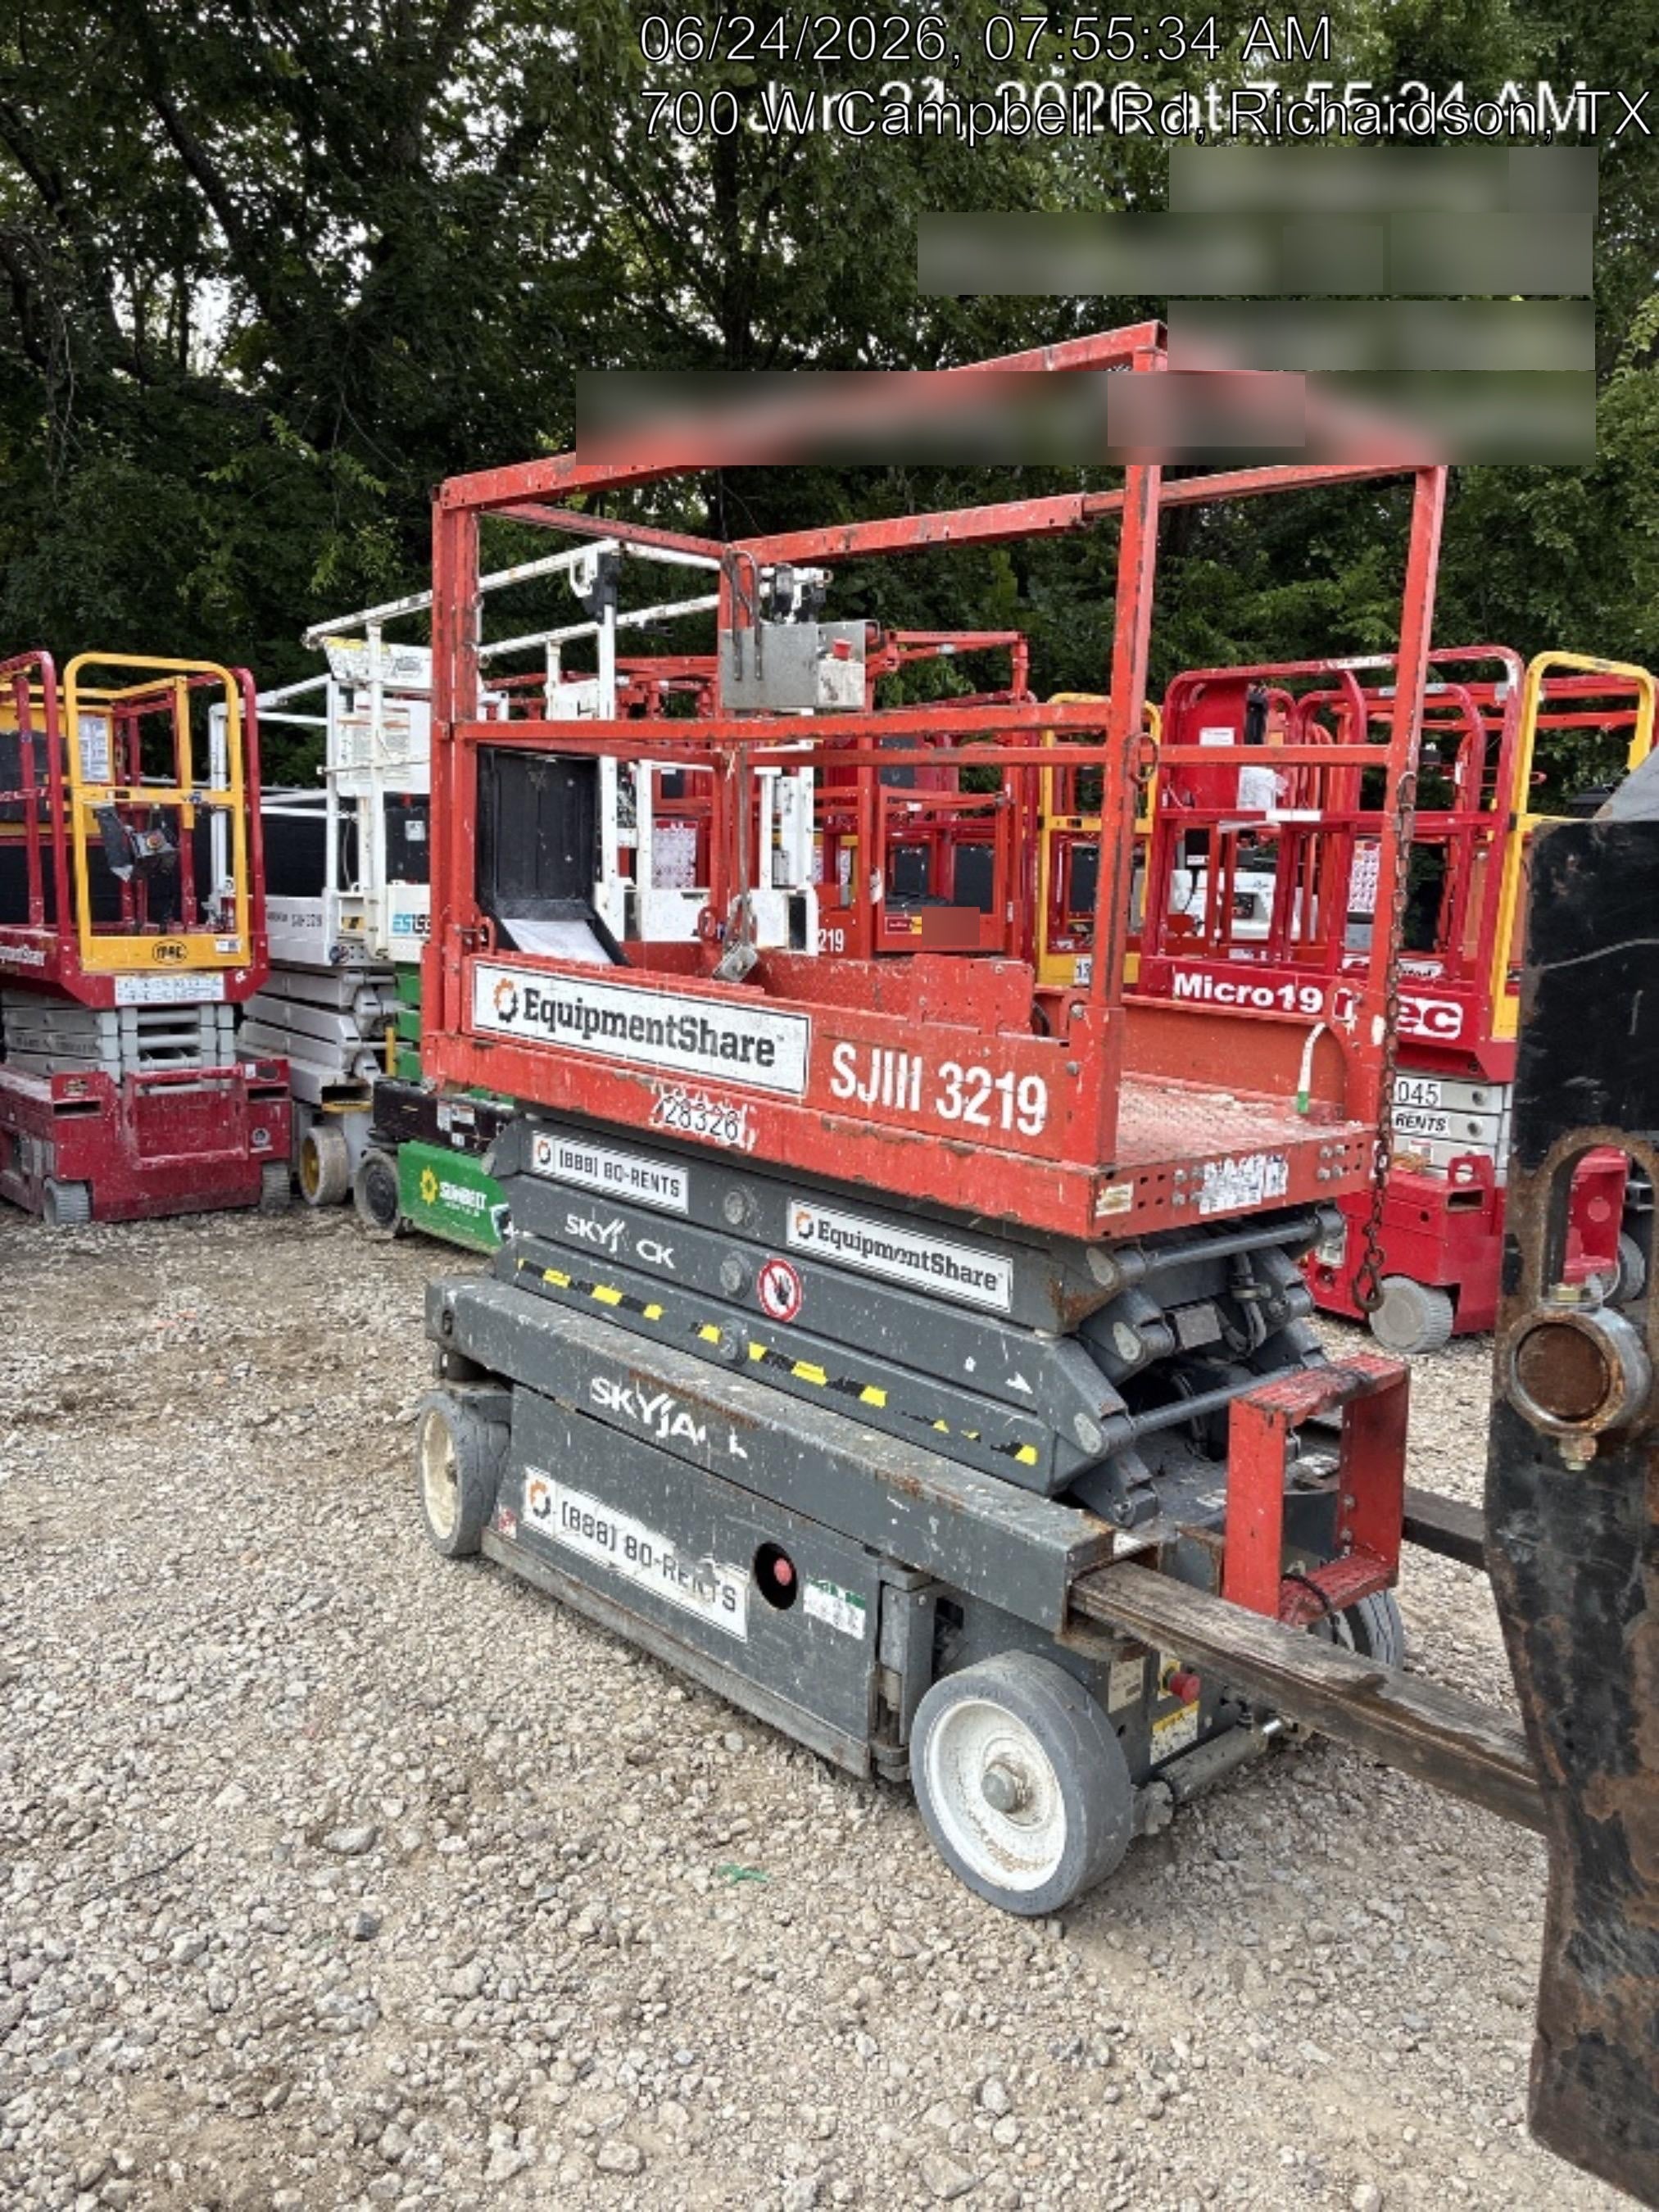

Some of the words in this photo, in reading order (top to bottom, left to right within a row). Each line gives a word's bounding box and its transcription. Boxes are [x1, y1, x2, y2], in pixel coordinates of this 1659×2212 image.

[1173, 972, 1324, 1015] Micro19
[522, 987, 777, 1068] EquipmentShare
[935, 1059, 1049, 1137] 3219
[603, 1160, 680, 1199] 80-RENTS
[564, 1213, 677, 1269] SKYJCK
[818, 1217, 998, 1292] EquipmentShare
